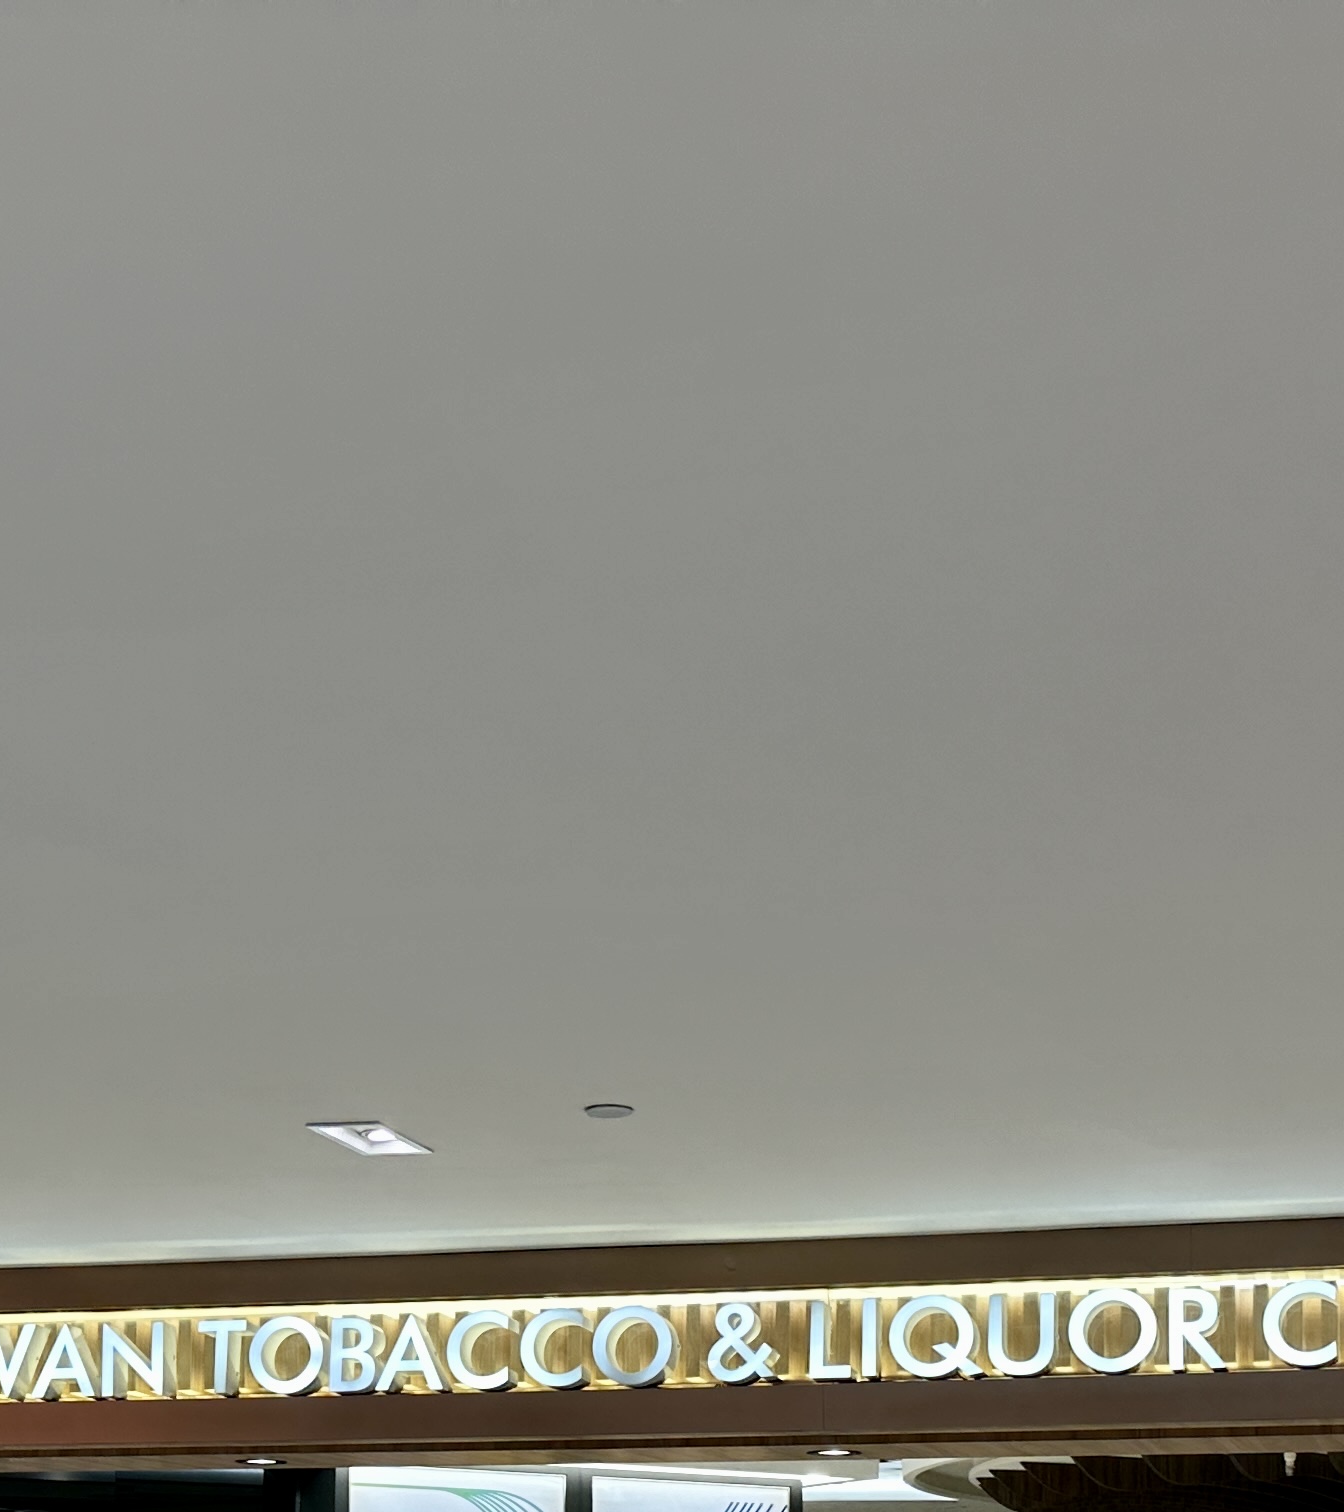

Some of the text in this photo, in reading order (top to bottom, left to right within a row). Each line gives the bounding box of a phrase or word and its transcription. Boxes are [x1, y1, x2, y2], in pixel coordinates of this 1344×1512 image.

[196, 1306, 674, 1395] TOBACCO
[707, 1302, 776, 1386] &
[809, 1288, 1229, 1380] LIQUOR
